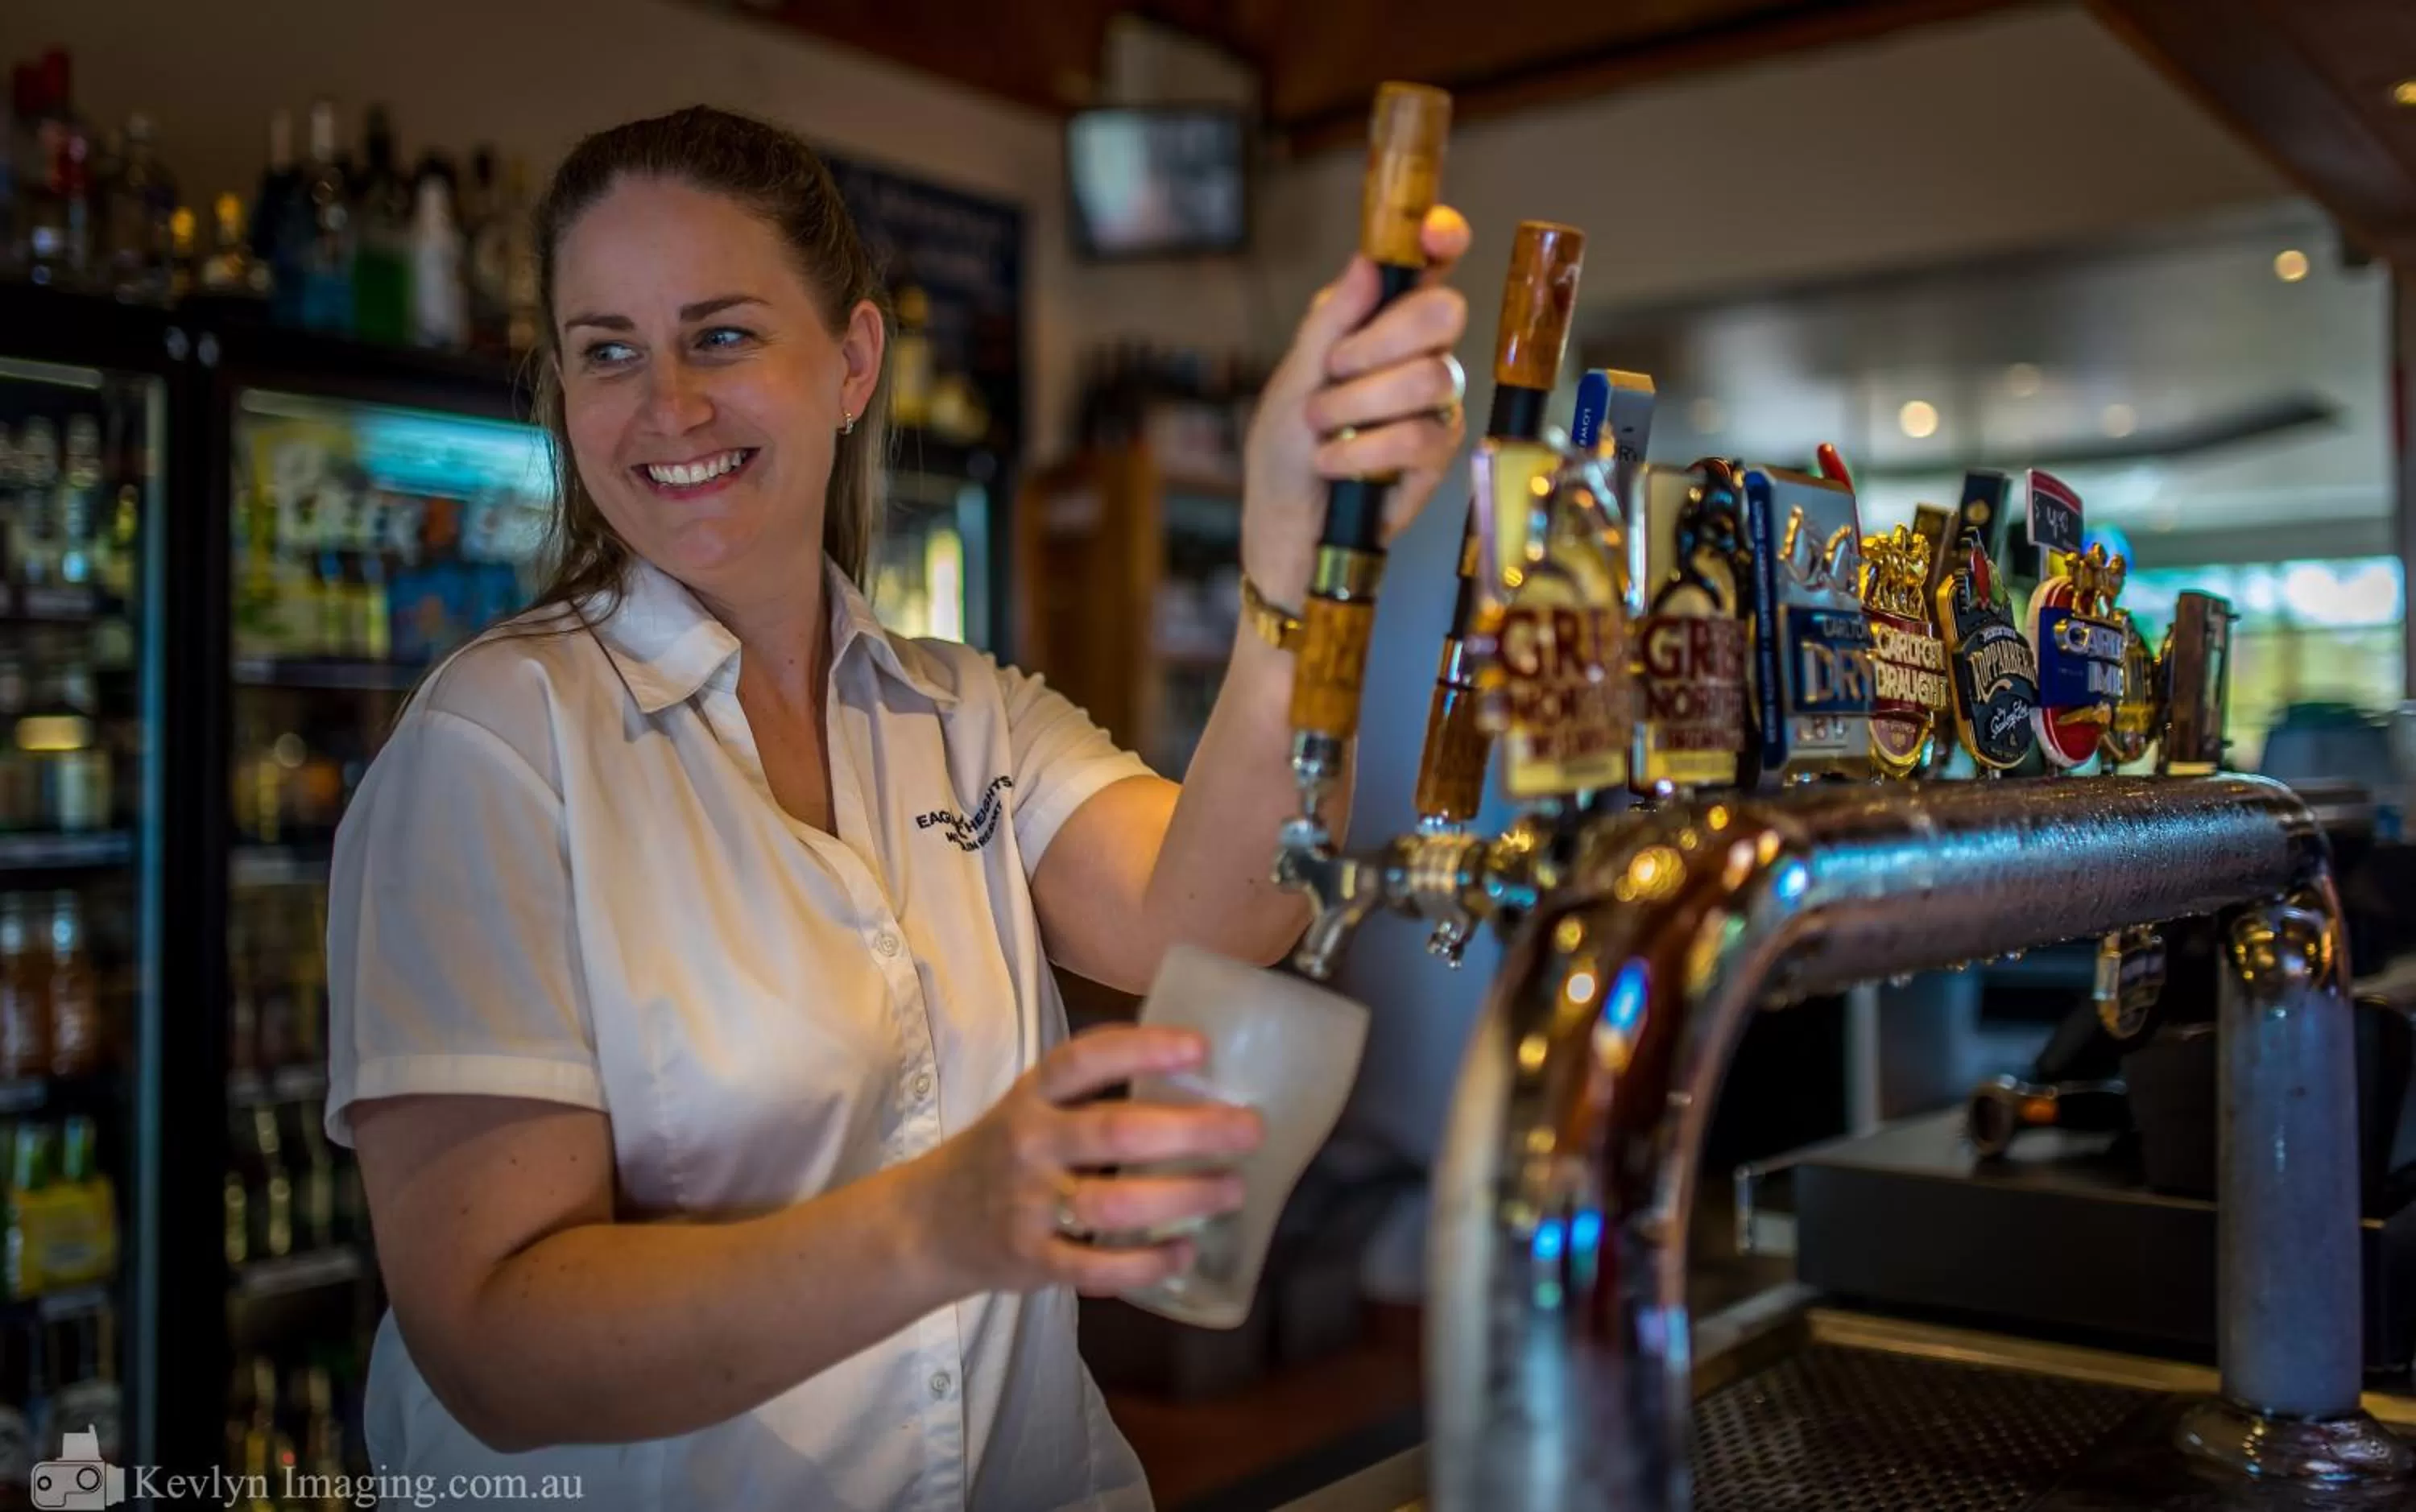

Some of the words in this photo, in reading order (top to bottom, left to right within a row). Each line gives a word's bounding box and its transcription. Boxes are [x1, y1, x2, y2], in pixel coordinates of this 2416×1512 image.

[1876, 624, 1944, 671] CARLTON
[1876, 660, 1949, 708] DRAUGHT
[965, 775, 1013, 833] HEIGHTS
